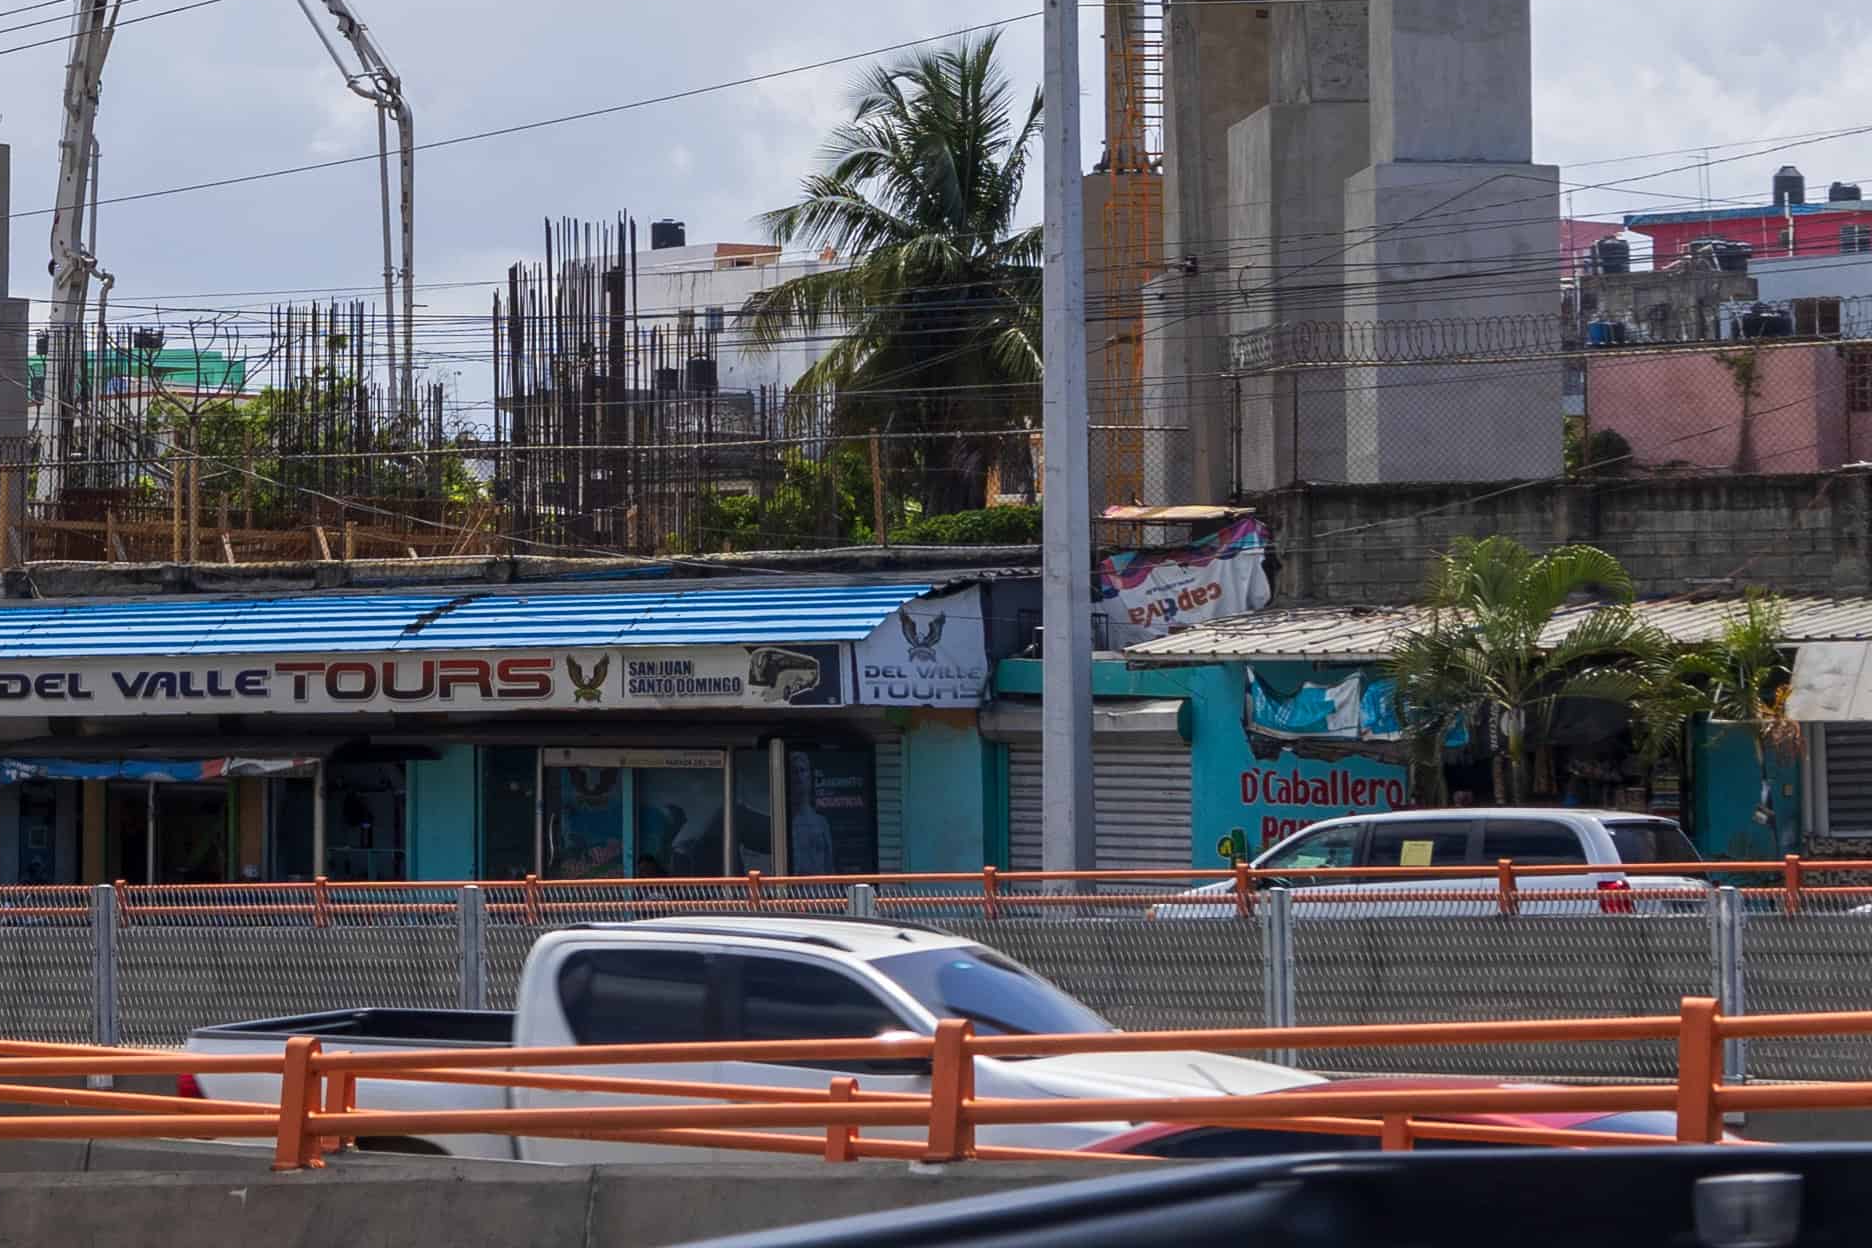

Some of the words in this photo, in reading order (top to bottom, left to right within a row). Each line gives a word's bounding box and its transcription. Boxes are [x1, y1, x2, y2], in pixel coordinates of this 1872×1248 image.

[1127, 581, 1223, 628] captiva
[629, 660, 655, 677] SAN
[658, 660, 692, 676] JUAN
[864, 664, 907, 679] DEL
[112, 669, 272, 699] VALLE
[274, 657, 556, 702] TOURS
[629, 678, 673, 695] SANTO
[676, 676, 741, 694] DOMINGO
